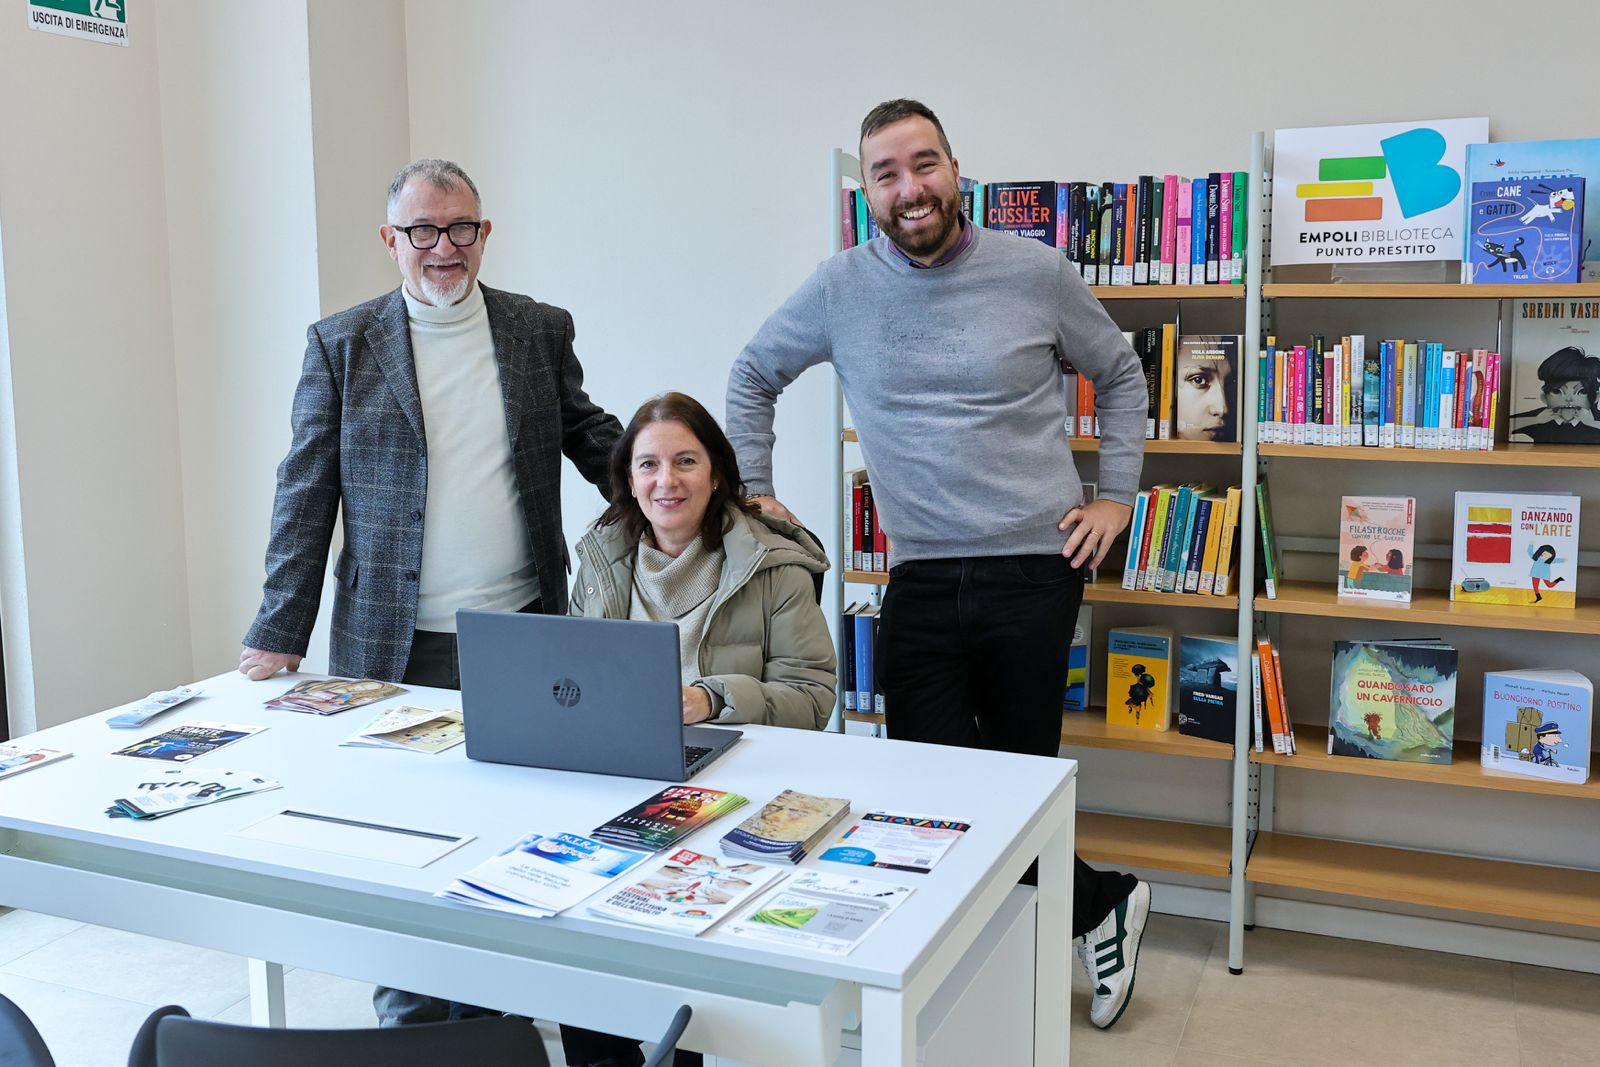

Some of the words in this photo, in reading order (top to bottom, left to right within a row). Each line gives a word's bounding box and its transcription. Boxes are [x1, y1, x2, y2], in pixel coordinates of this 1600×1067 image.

[32, 11, 64, 27] USCITA
[66, 18, 74, 29] DI
[76, 20, 124, 38] EMERGENZA
[1000, 190, 1039, 206] CLIVE
[1497, 186, 1522, 198] CANE
[989, 207, 1050, 224] CUSSLER
[1486, 203, 1517, 215] GATTO
[1020, 229, 1046, 237] VIAGGIO
[1300, 232, 1357, 243] EMPOLI
[1362, 228, 1454, 242] BIBLIOTECA
[1316, 247, 1363, 256] PUNTO
[1369, 244, 1436, 256] PRESTITO
[1522, 303, 1564, 318] SREDNI
[1522, 511, 1572, 523] DANZANDO
[1350, 525, 1406, 536] FILASTROCCHE
[1535, 522, 1572, 537] L'ARTE
[1358, 680, 1404, 690] QUANDO
[554, 678, 581, 708] hp
[1357, 692, 1370, 701] UN
[1373, 694, 1442, 706] CAVERNICOLO
[1548, 700, 1581, 711] POSTINO
[612, 894, 635, 904] DELLA
[635, 901, 667, 911] LETTURA
[618, 891, 650, 902] FESTIVAL
